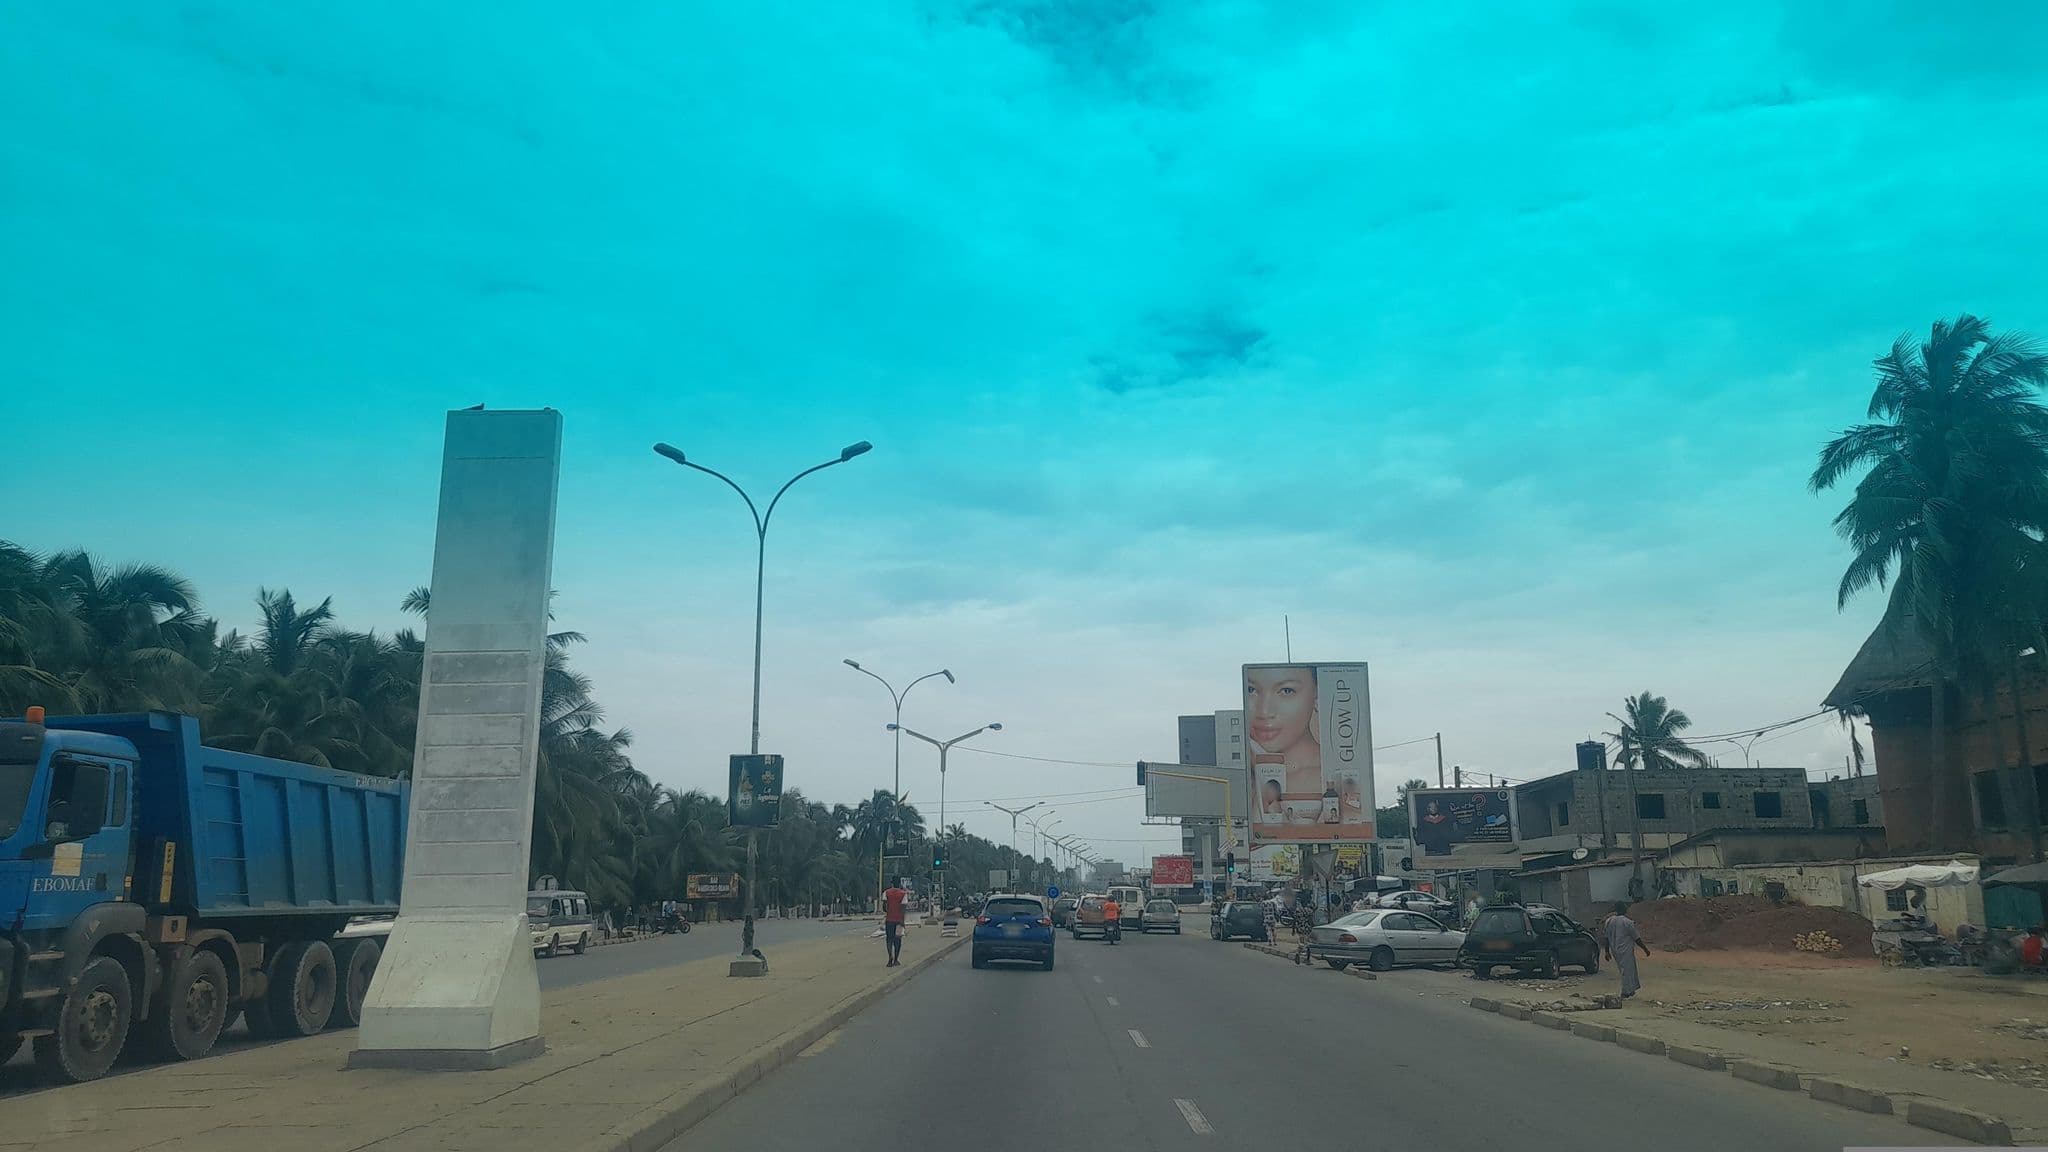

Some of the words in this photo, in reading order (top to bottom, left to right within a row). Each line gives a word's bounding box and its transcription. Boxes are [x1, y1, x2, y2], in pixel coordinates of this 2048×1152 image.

[1336, 679, 1352, 703] UP
[1337, 708, 1355, 762] GLOW
[32, 877, 97, 892] EBOMAF
